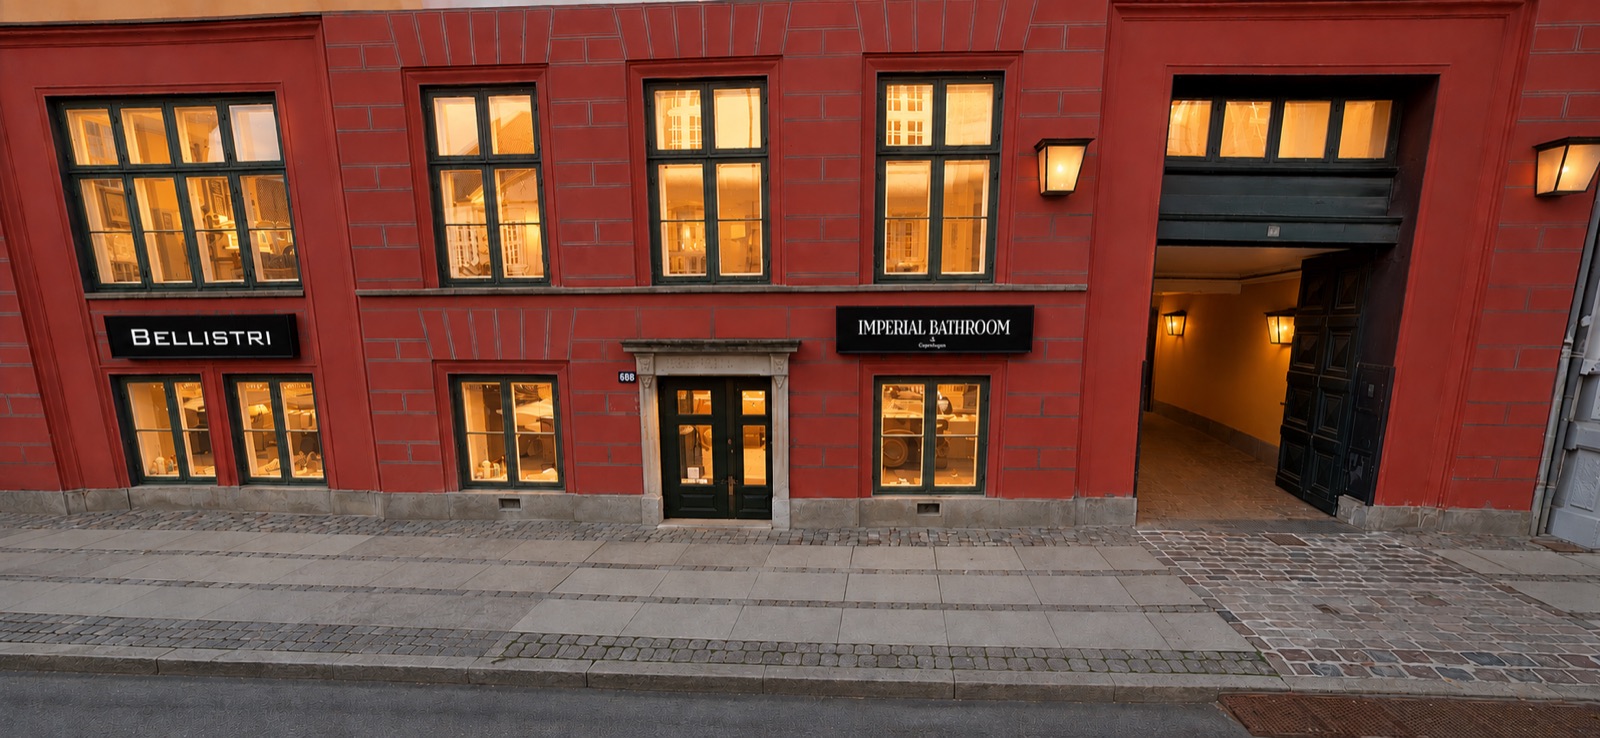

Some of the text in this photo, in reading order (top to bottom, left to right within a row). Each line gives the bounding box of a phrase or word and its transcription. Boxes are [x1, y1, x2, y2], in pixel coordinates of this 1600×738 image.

[858, 319, 1011, 336] IMPERIAL BATHROOM
[130, 328, 272, 346] BELLISTRI
[918, 342, 947, 350] Copenhagen
